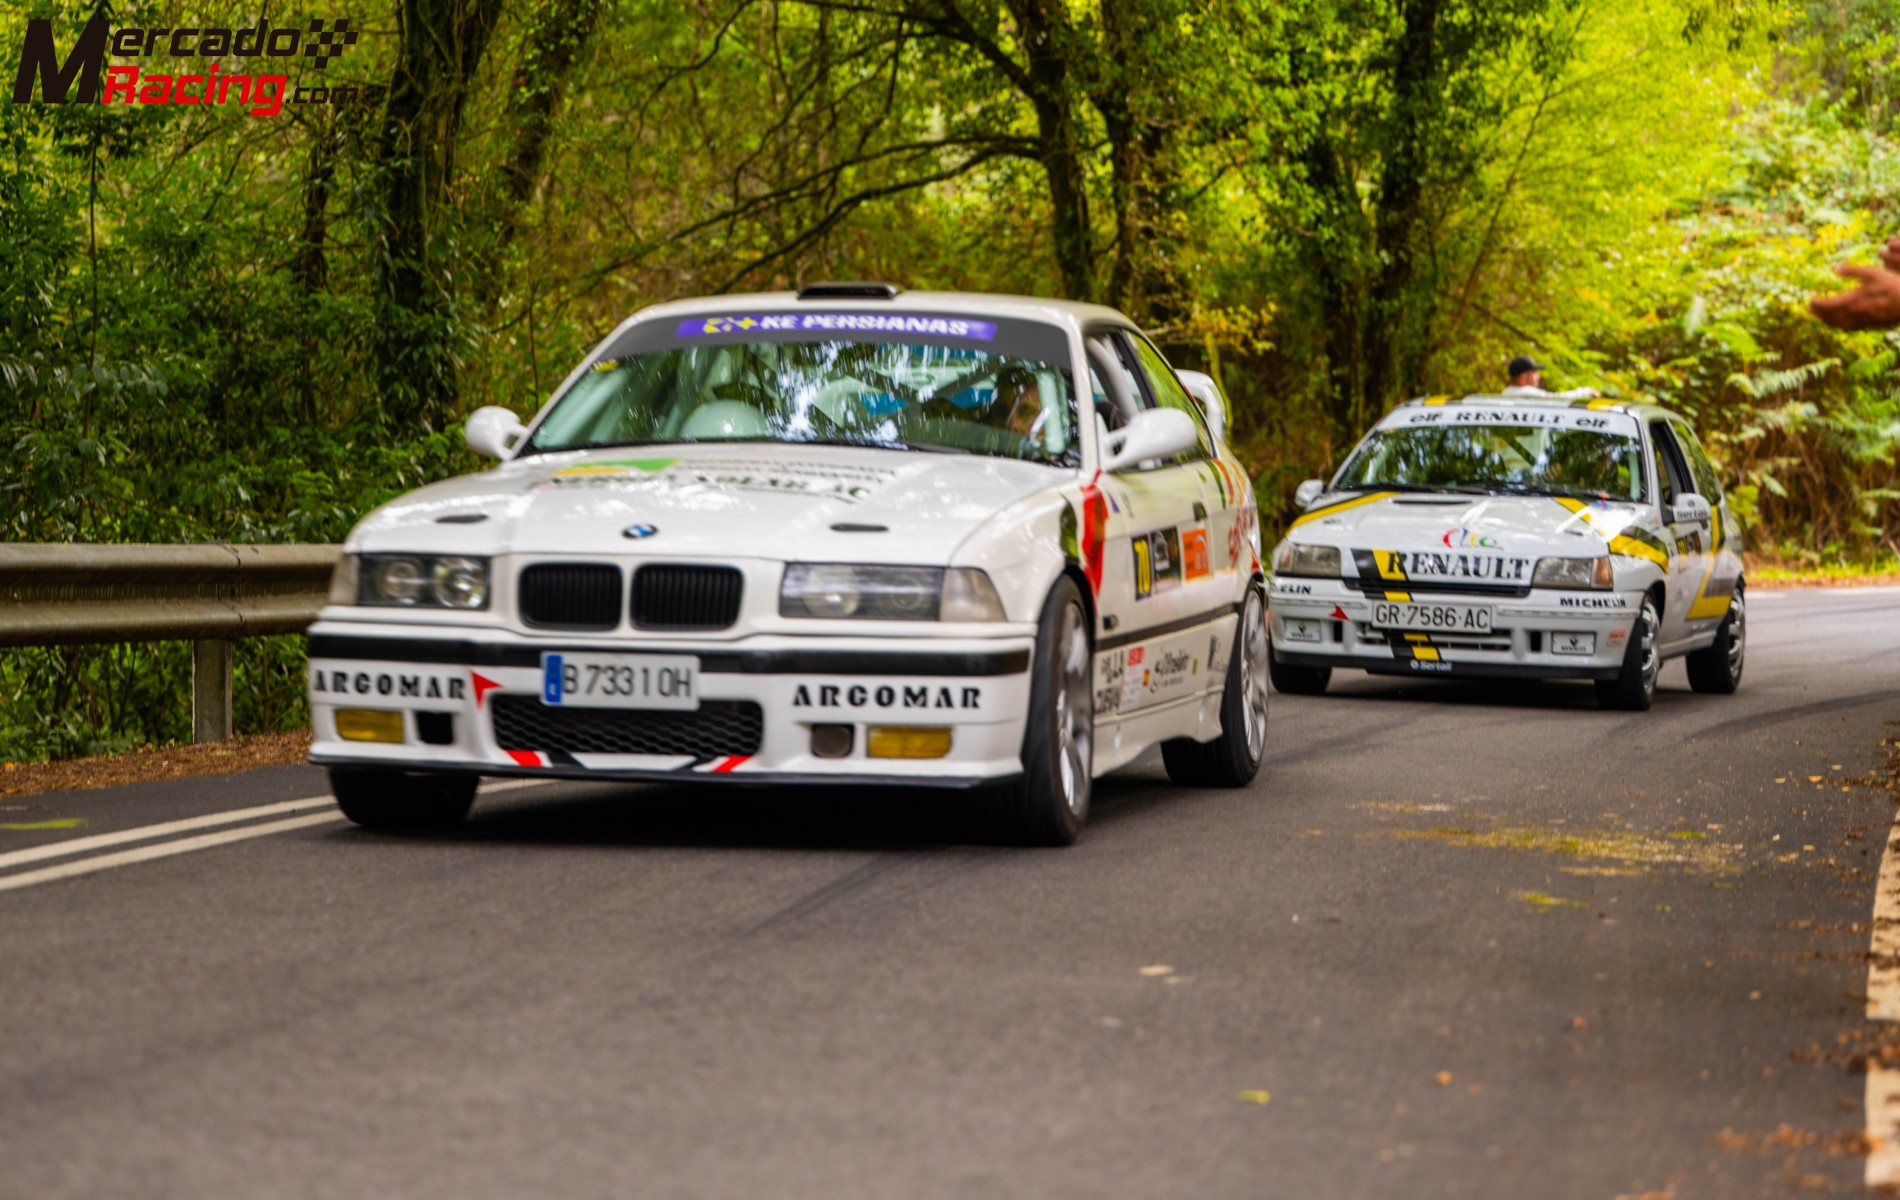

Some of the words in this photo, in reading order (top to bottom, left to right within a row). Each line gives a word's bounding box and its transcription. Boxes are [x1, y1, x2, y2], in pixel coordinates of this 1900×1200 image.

[760, 314, 796, 330] KE
[802, 314, 969, 336] PERSIANAS
[1455, 411, 1564, 425] RENAULT
[1386, 551, 1530, 580] RENAULT
[1276, 584, 1311, 595] ELIN
[1560, 597, 1627, 609] MICHELIN
[312, 670, 467, 700] ARGOMAR
[792, 683, 981, 709] ARGOMAR
